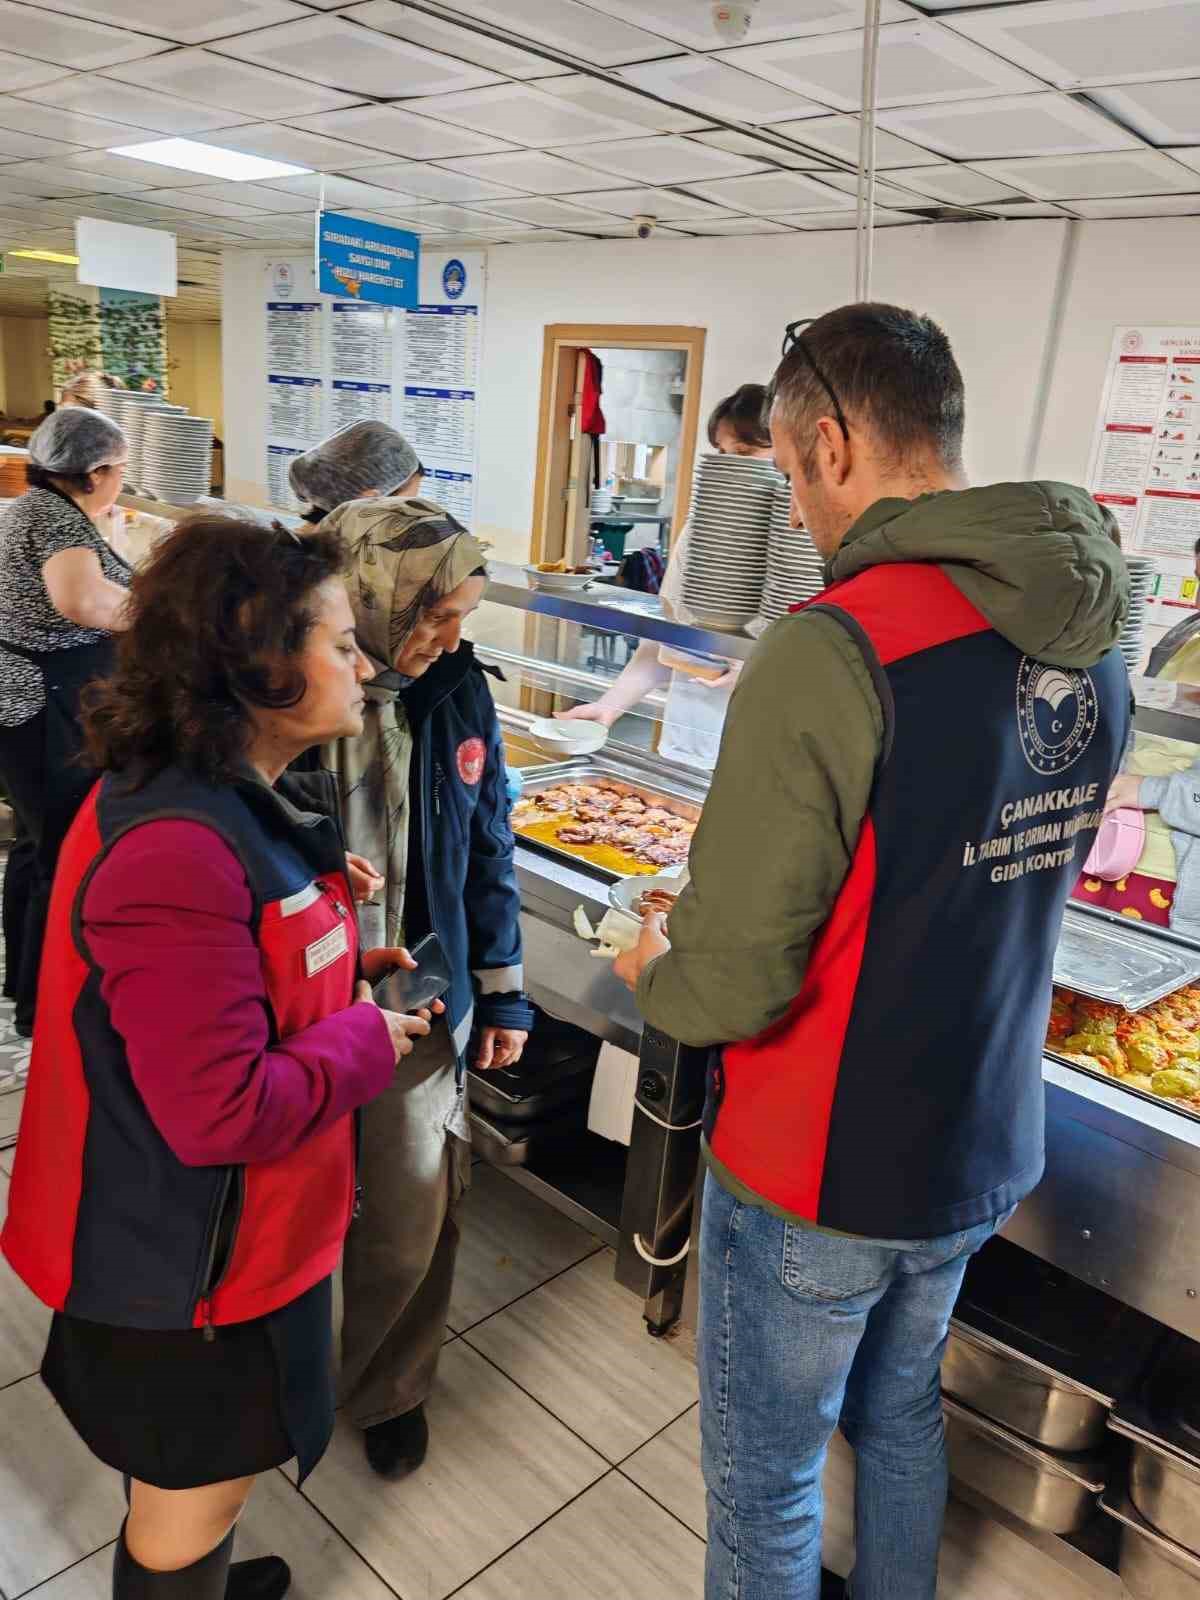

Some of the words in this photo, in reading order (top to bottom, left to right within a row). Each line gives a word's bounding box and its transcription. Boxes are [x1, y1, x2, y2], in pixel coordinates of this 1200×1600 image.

[1000, 782, 1099, 830] ÇANAKKALE
[963, 841, 976, 867] İL
[978, 836, 1012, 862] TARIM
[1014, 832, 1025, 853] VE
[1025, 822, 1061, 848] ORMAN
[990, 860, 1024, 883] GIDA
[1026, 847, 1074, 872] KONTR
